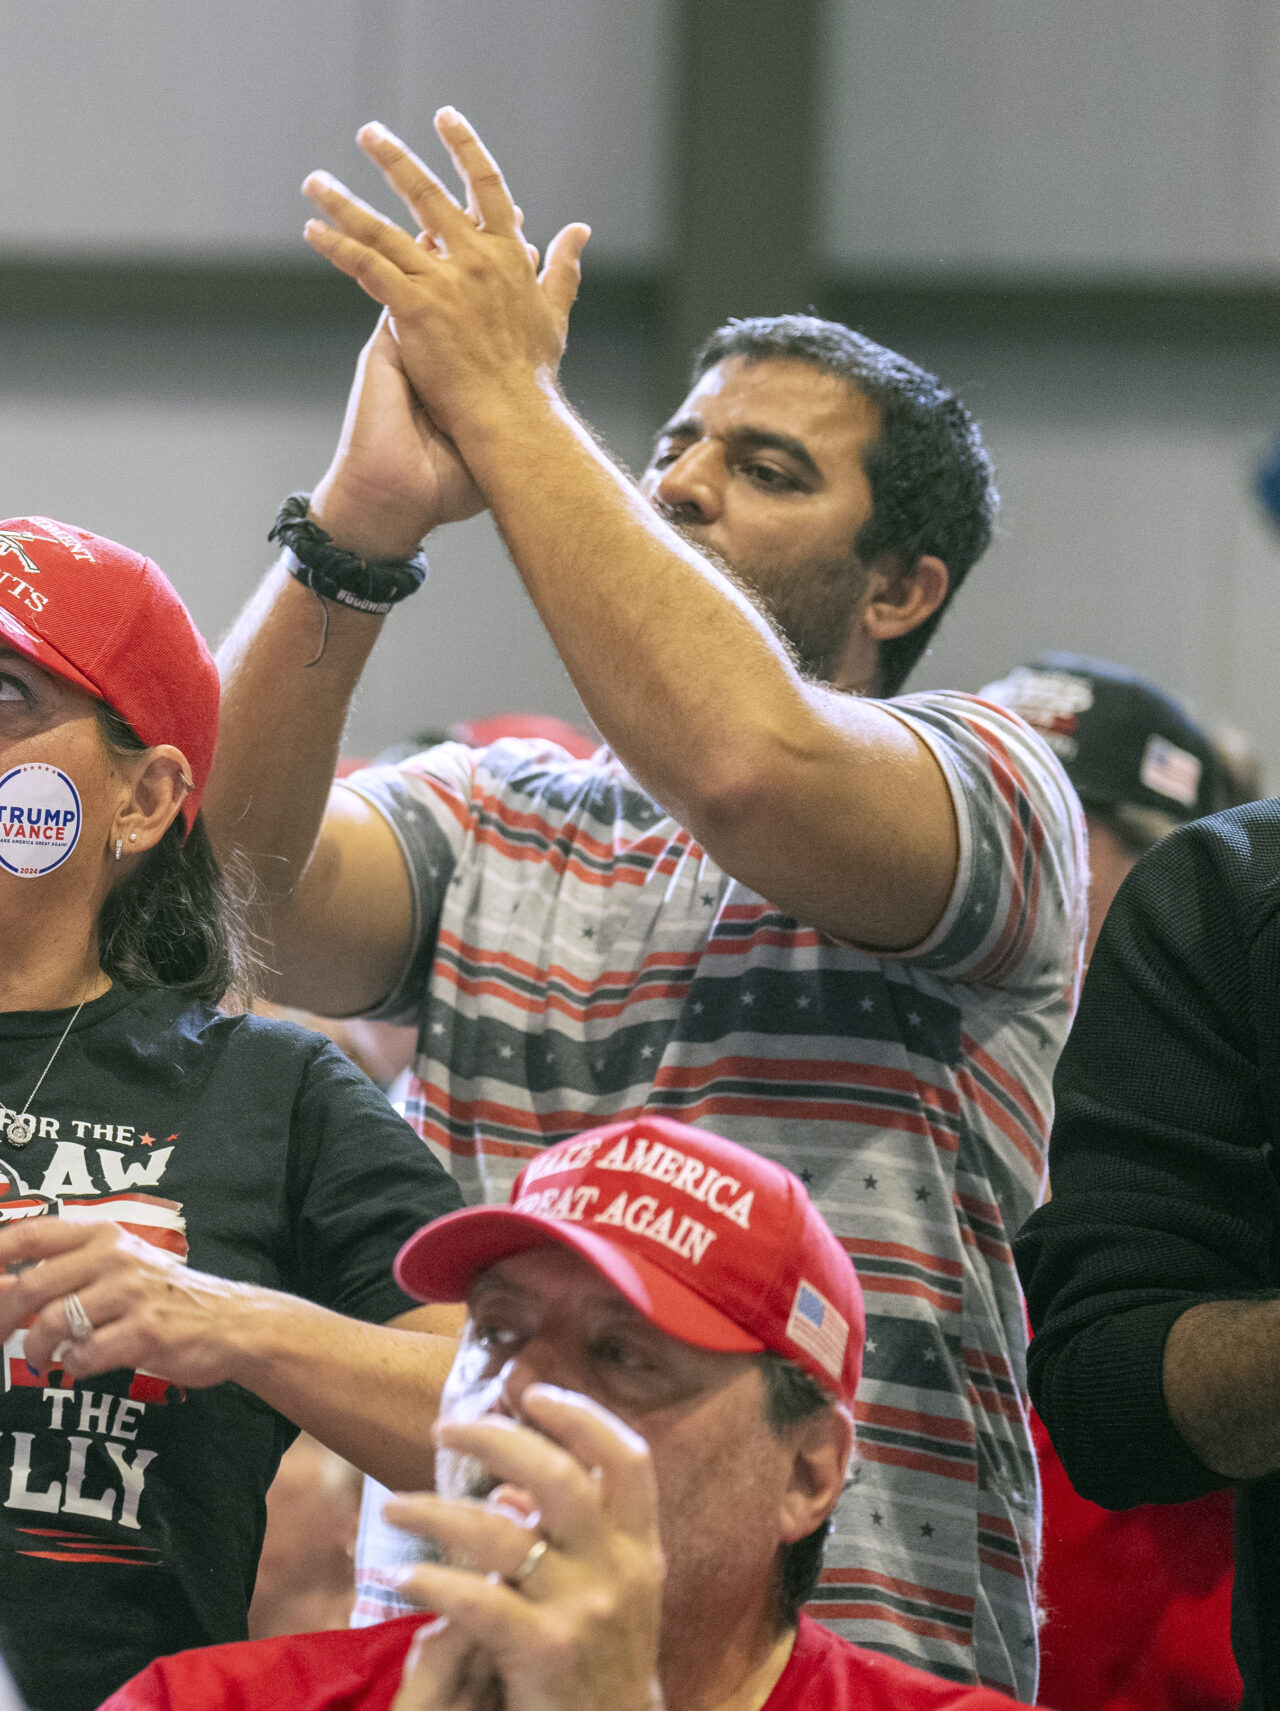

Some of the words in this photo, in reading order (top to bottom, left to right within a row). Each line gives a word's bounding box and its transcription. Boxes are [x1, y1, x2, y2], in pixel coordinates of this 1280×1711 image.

[2, 823, 66, 841] VANCE
[71, 1120, 136, 1147] THE
[594, 1136, 755, 1230] AMERICA
[593, 1190, 717, 1265] AGAIN
[42, 1387, 146, 1441] THE
